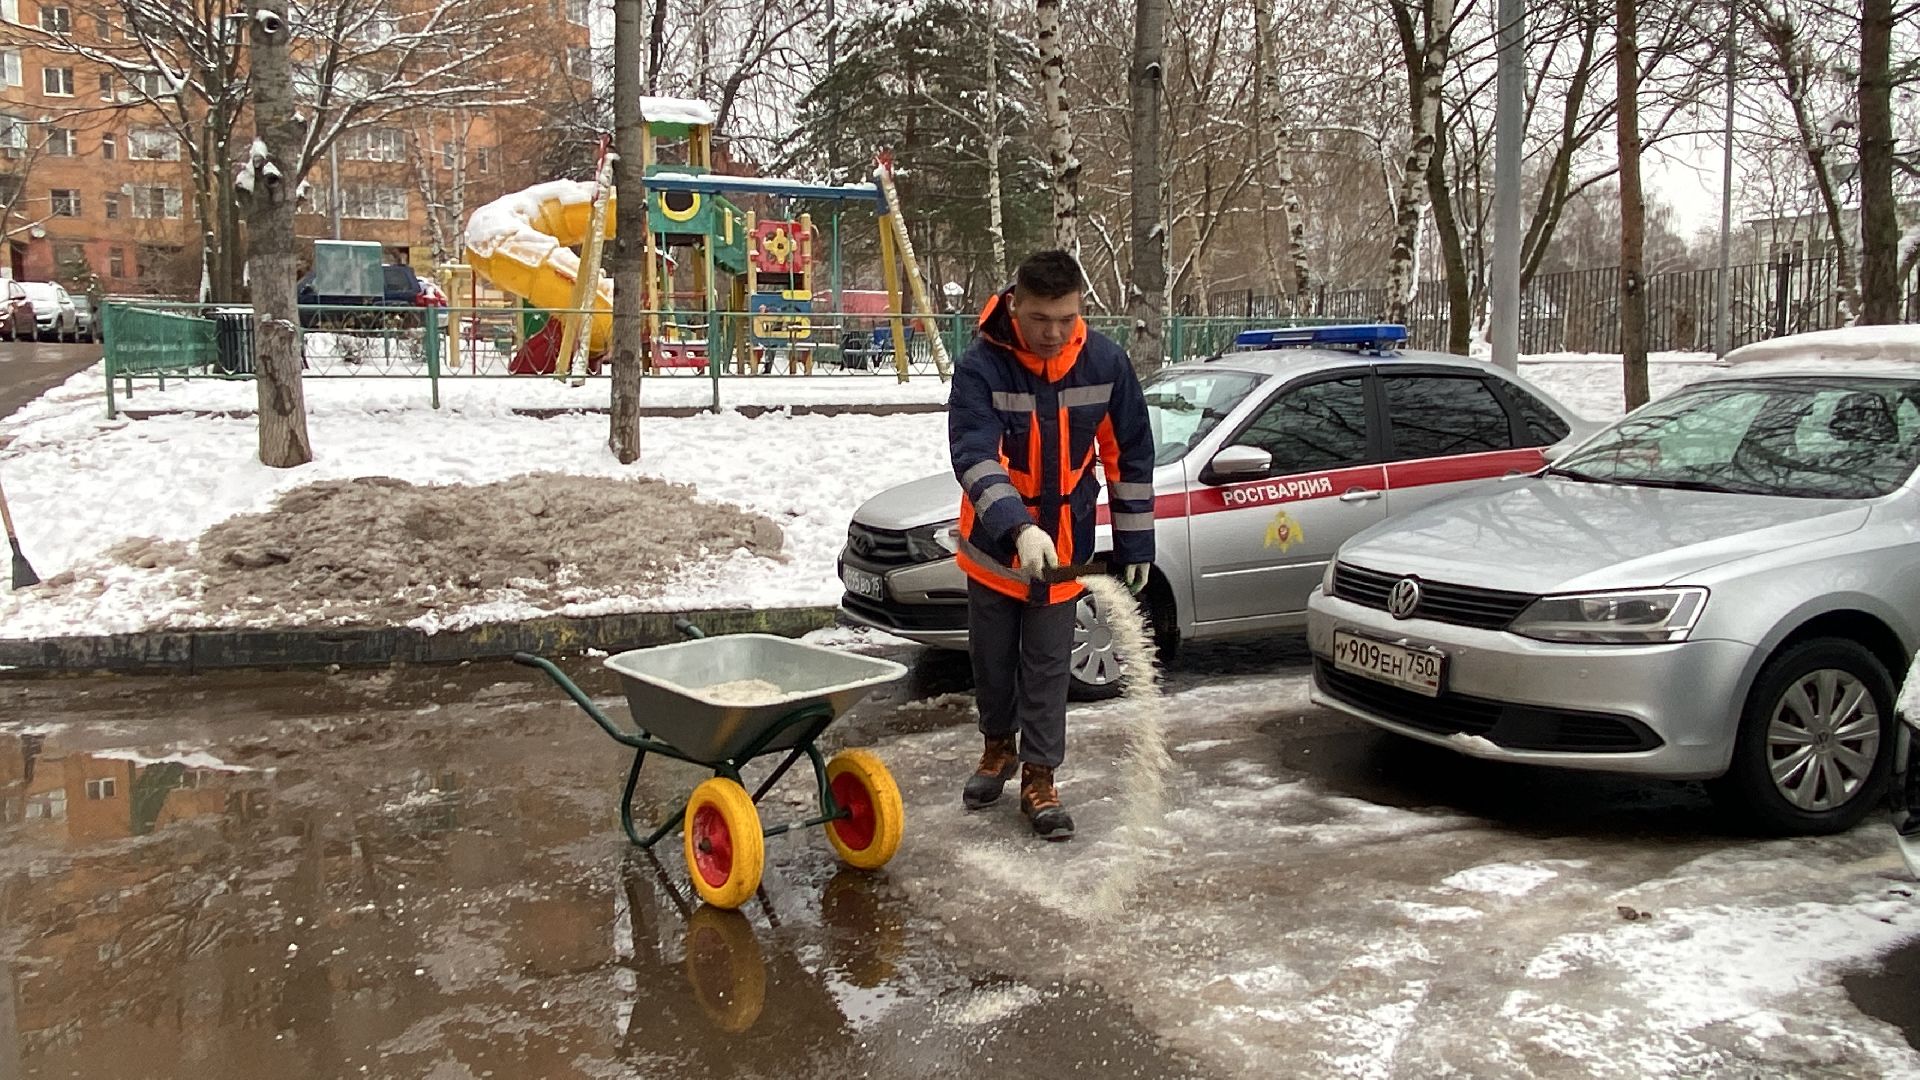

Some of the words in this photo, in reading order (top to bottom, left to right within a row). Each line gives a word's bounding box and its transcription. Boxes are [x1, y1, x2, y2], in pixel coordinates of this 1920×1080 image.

[1221, 477, 1333, 506] РОСГВАРДИЯ
[1340, 639, 1403, 676] У909ЕН
[1407, 653, 1435, 676] 750
